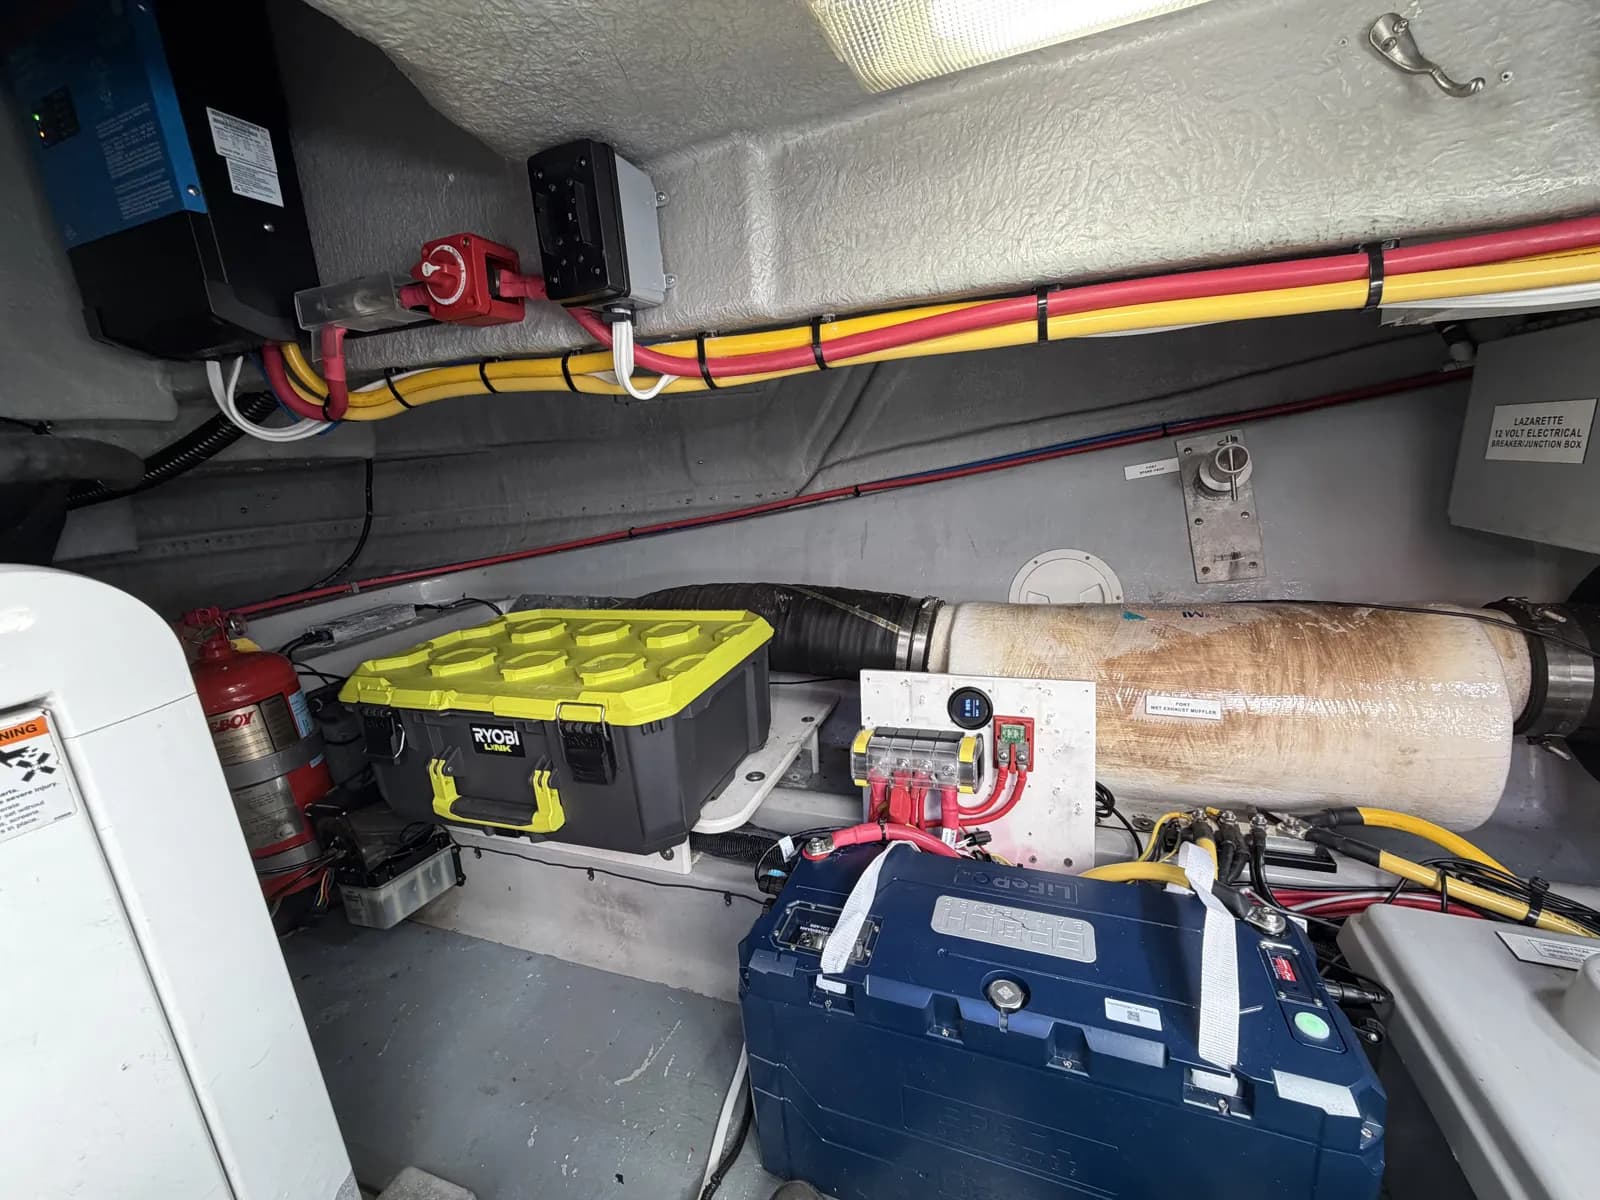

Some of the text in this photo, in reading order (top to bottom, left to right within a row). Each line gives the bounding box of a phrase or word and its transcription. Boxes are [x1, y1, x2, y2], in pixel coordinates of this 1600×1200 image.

[1513, 415, 1564, 426] LAZARETTE
[1495, 428, 1583, 438] 12 VOLT ELECTRICAL
[1491, 439, 1582, 448] BREAKER/JUNCTION BOX
[0, 723, 38, 741] NING
[472, 727, 520, 746] RYOBI
[484, 743, 512, 753] LINK
